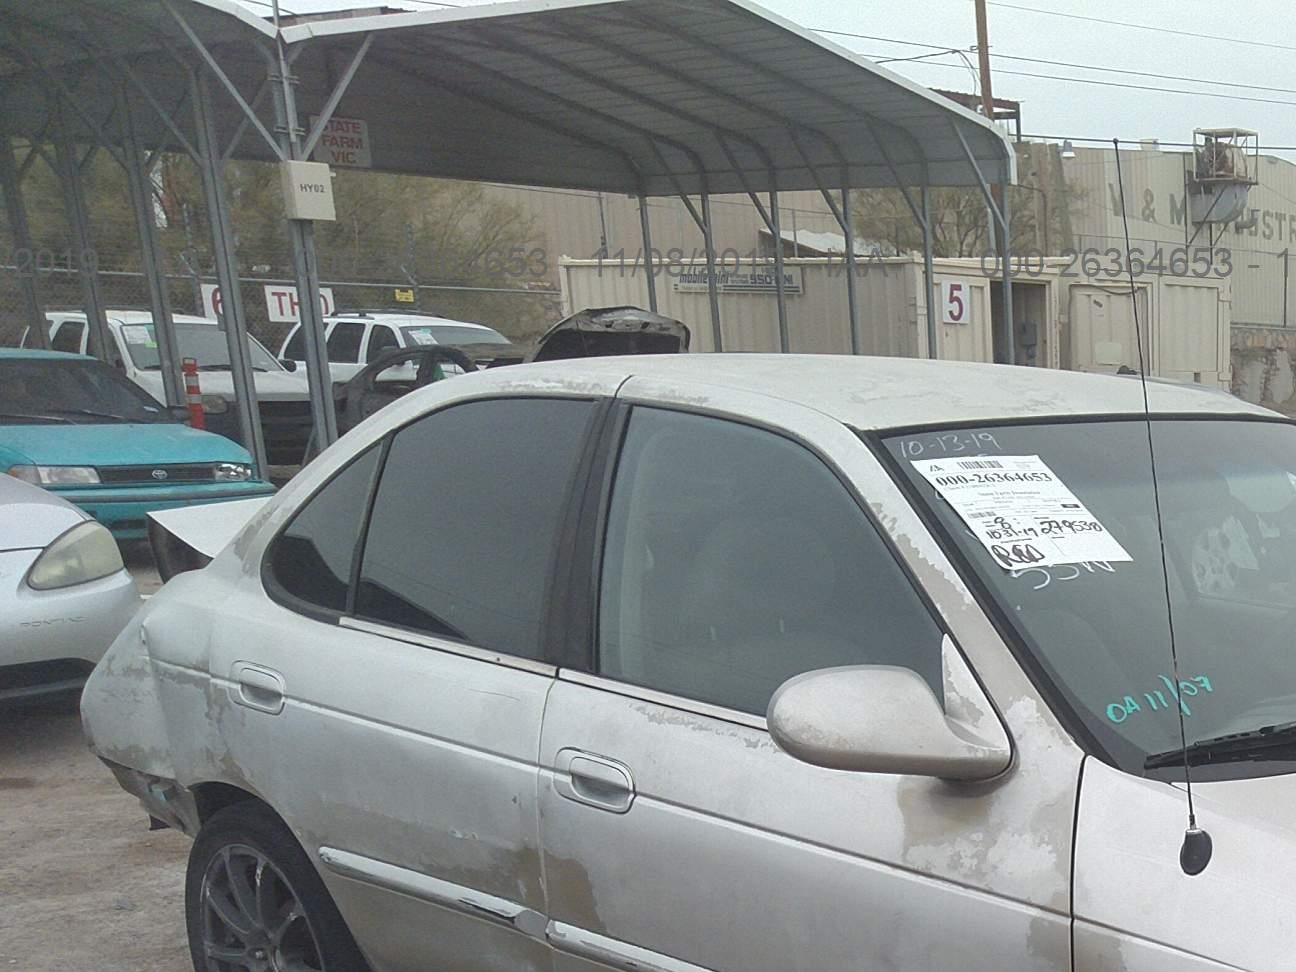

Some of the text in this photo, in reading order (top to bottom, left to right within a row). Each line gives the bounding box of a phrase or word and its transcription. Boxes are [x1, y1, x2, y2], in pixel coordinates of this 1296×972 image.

[300, 183, 325, 193] HY02
[1142, 188, 1157, 222] &
[948, 283, 964, 322] 5
[900, 432, 1001, 458] 10-13-19
[936, 472, 1052, 486] 000-26364653
